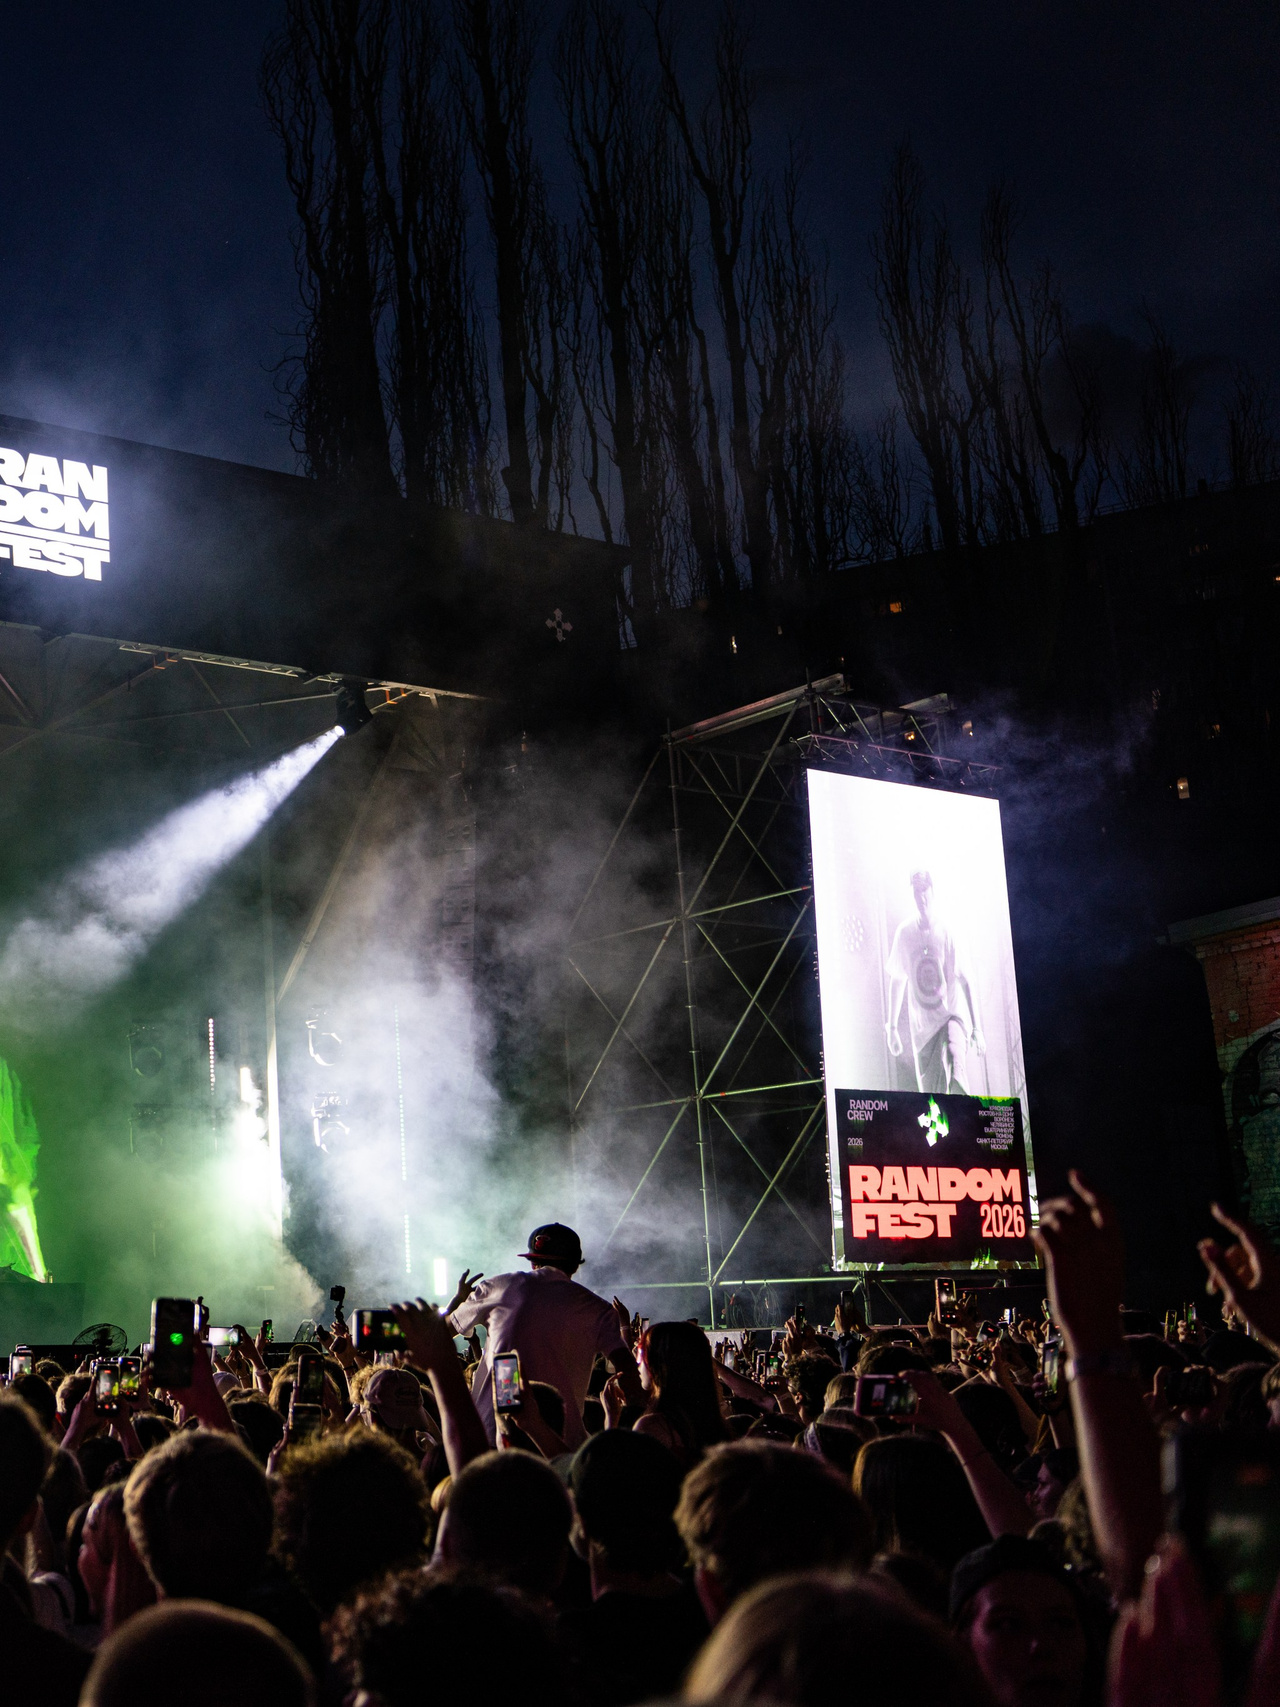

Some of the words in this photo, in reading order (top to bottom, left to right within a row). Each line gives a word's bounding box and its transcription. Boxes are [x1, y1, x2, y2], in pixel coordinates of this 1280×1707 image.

[849, 1099, 888, 1111] RANDOM
[847, 1110, 873, 1121] CREW
[847, 1137, 863, 1146] 2026
[849, 1165, 1022, 1202] RANDOM
[851, 1202, 957, 1238] FEST
[980, 1204, 1026, 1238] 2026
